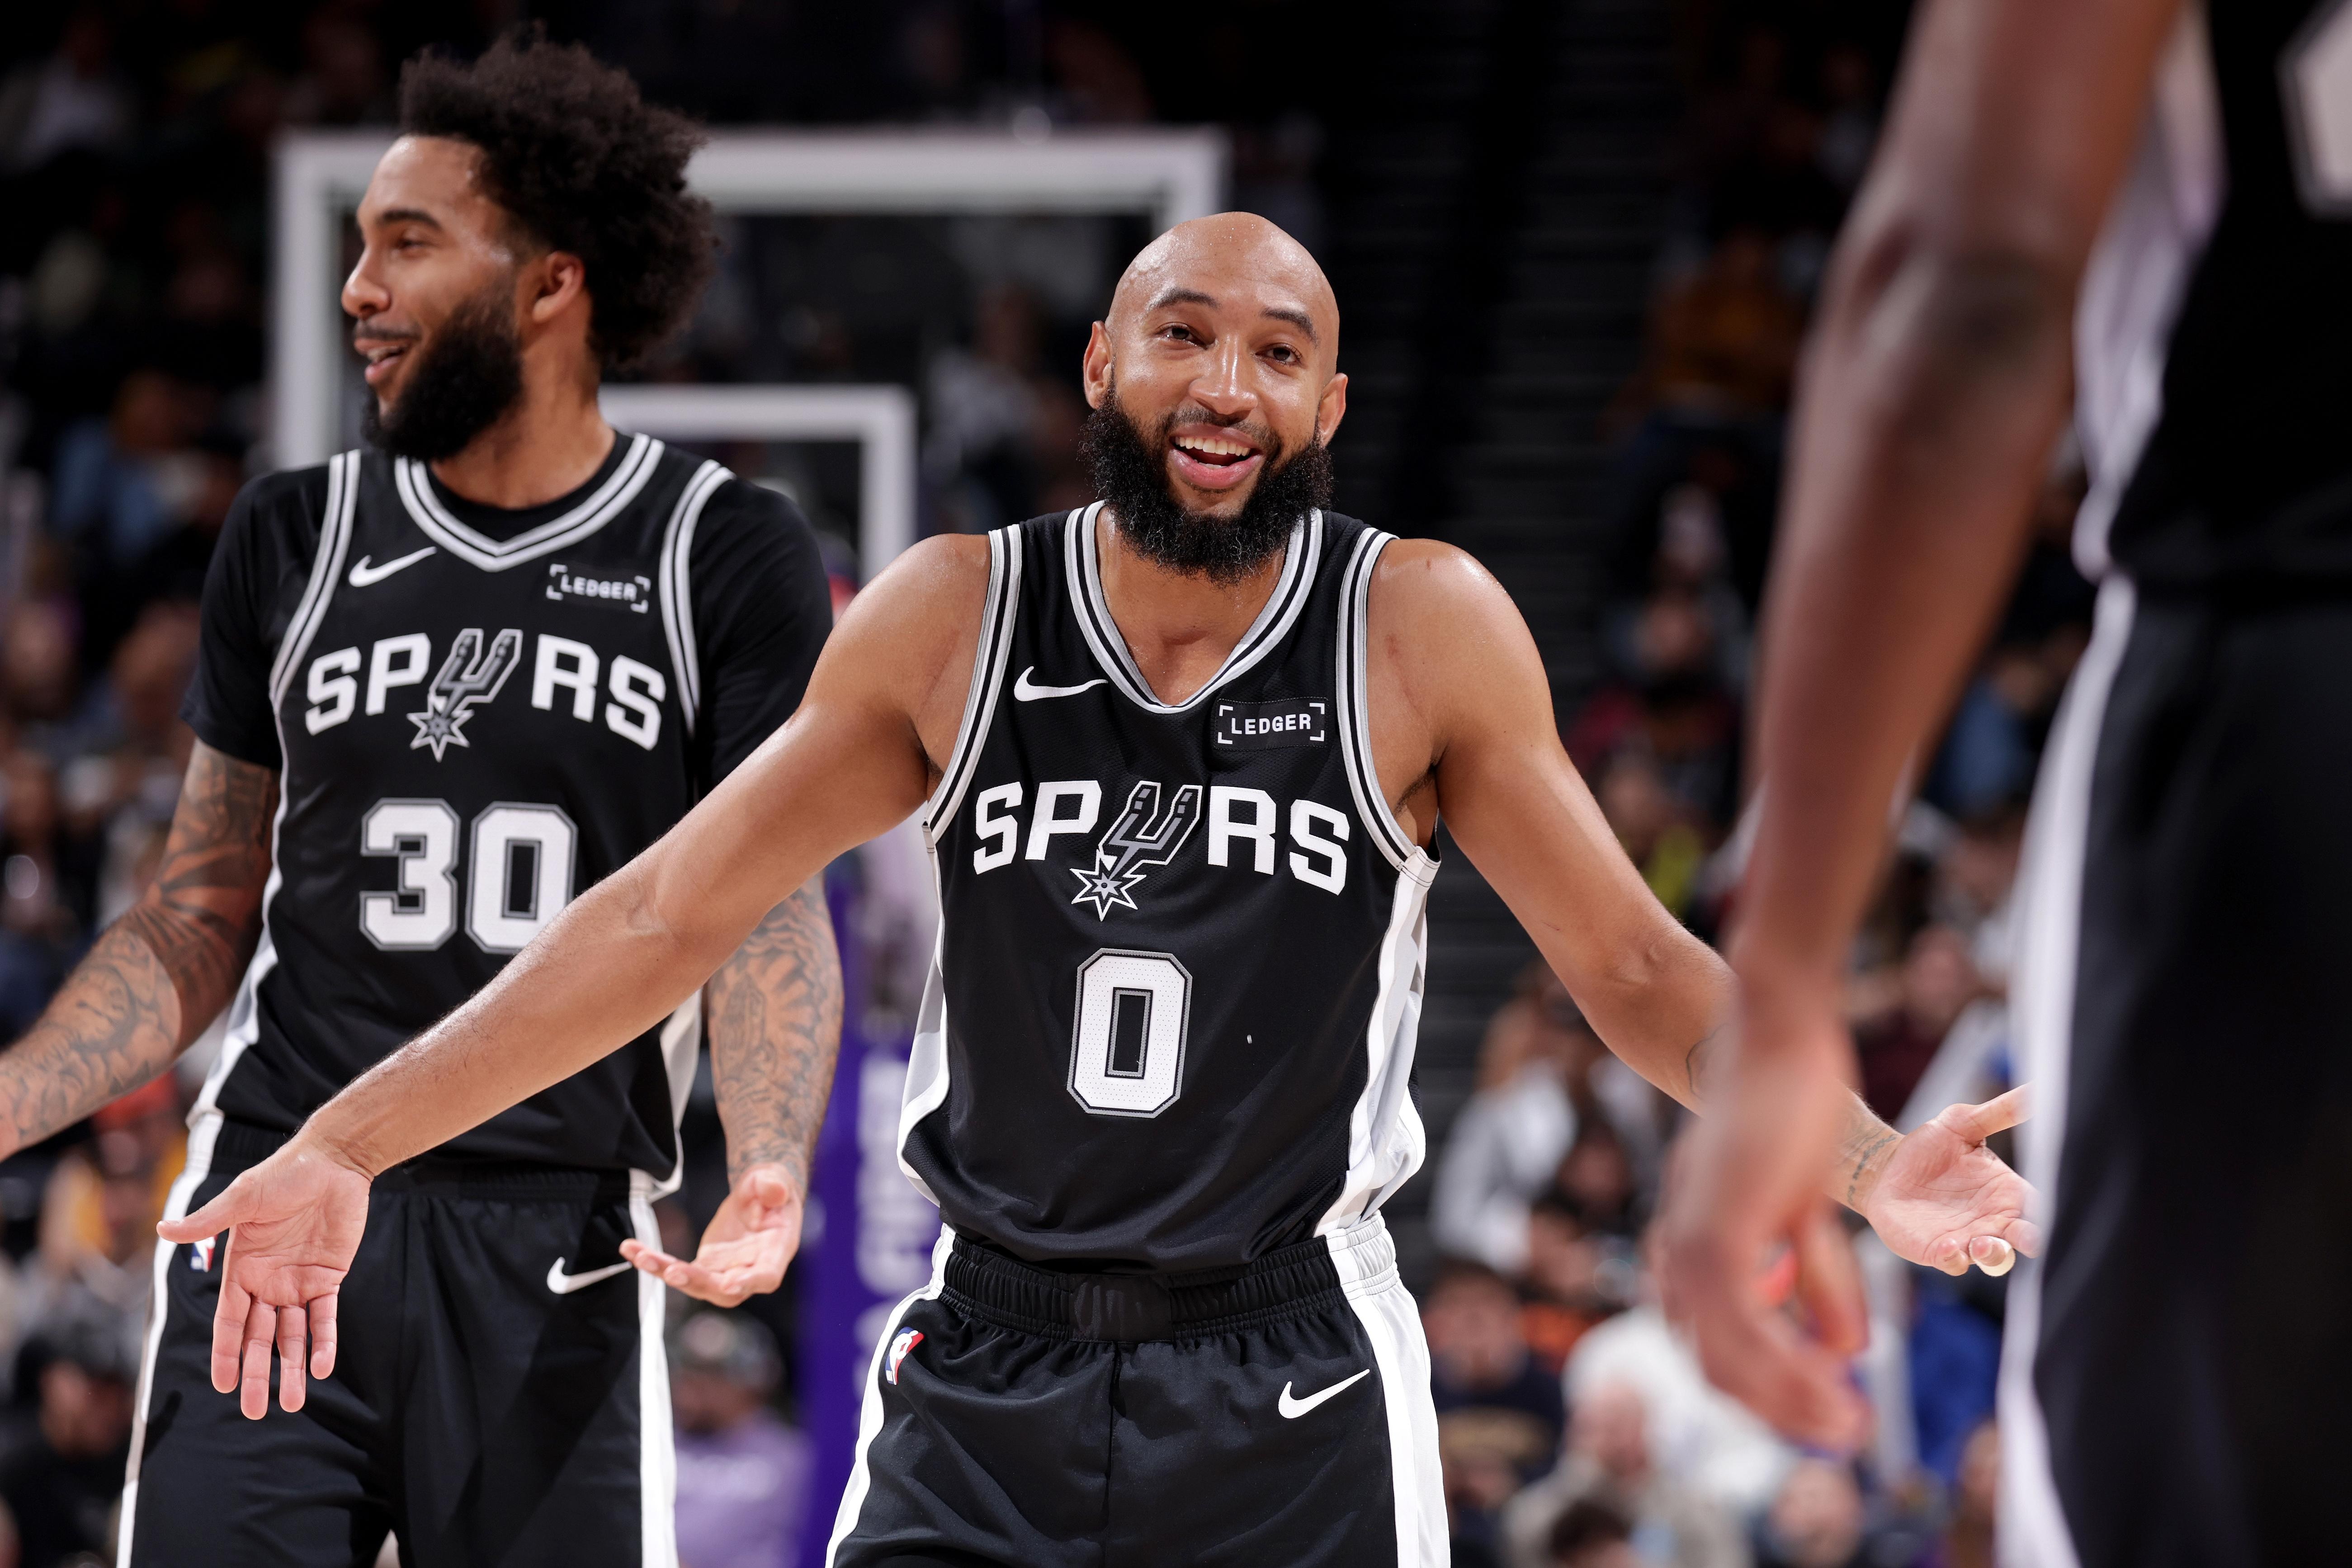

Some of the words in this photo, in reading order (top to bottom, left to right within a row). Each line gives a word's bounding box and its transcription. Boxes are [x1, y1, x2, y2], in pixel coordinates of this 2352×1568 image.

[560, 574, 638, 602] LEDGER
[1231, 713, 1312, 734] LEDGER
[359, 798, 577, 953] 30
[1067, 948, 1193, 1118] 0
